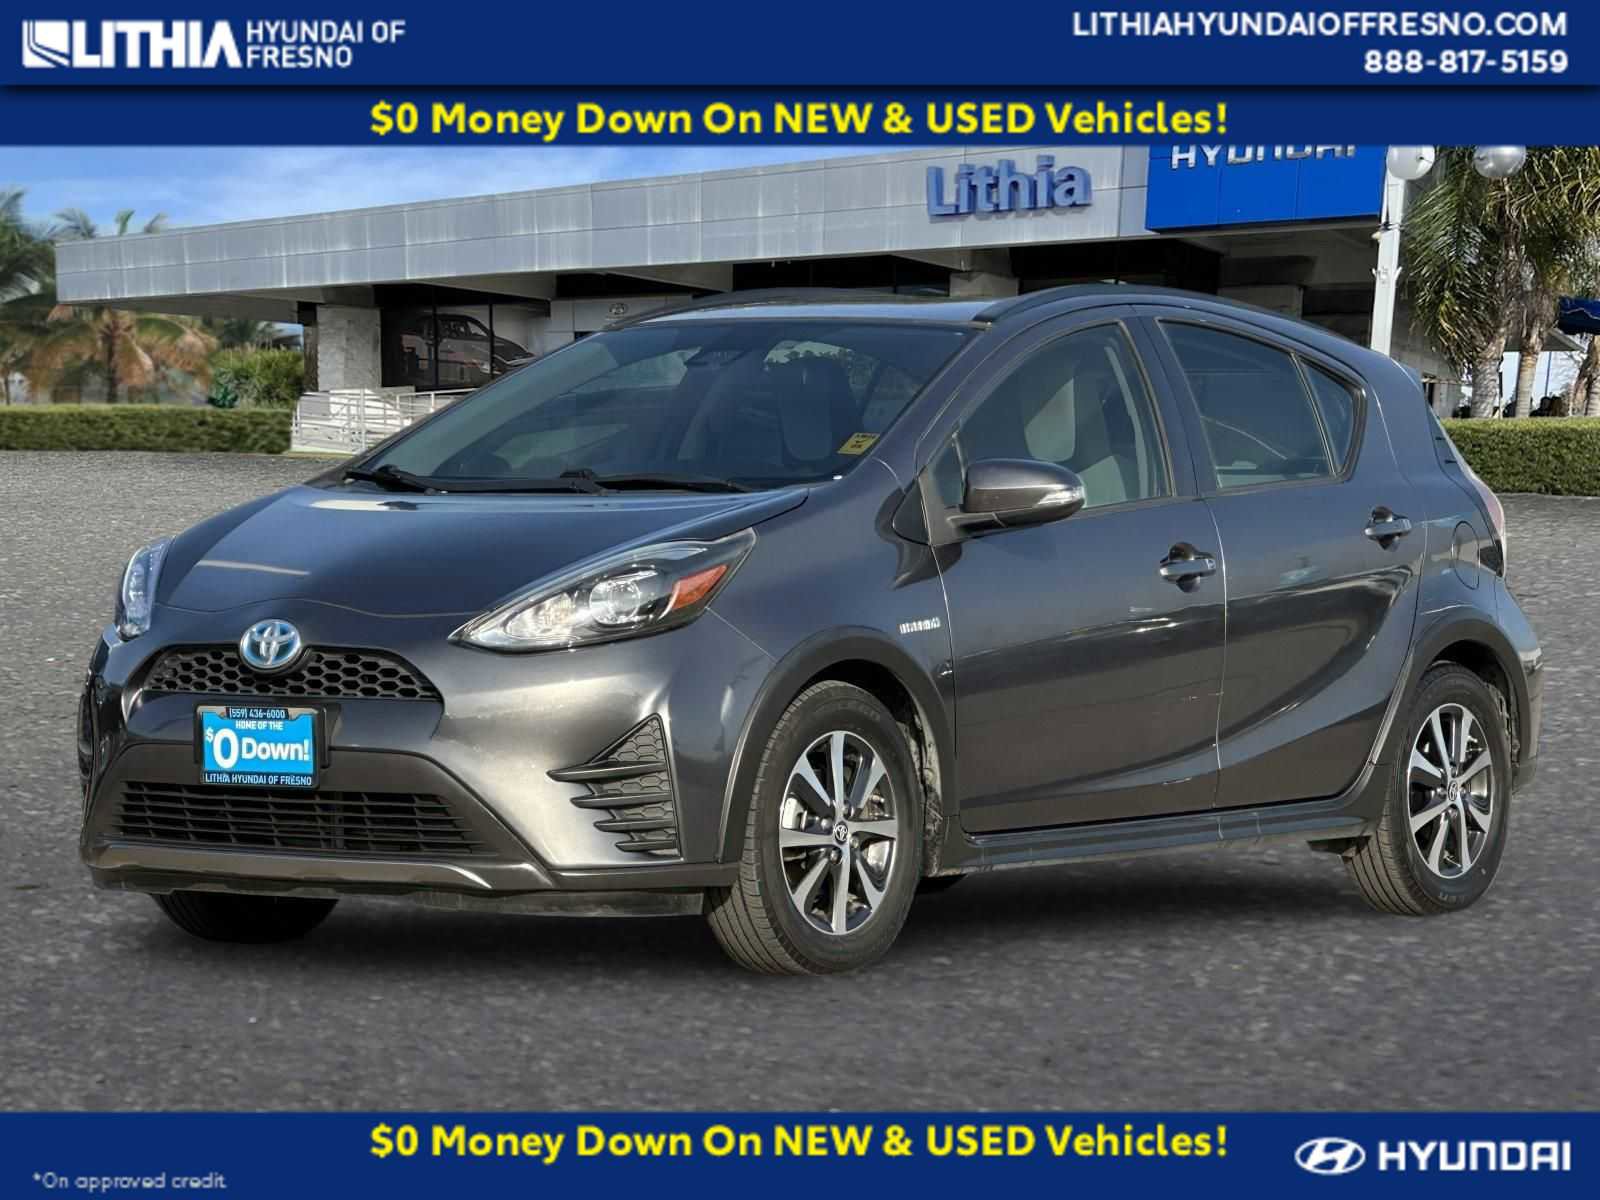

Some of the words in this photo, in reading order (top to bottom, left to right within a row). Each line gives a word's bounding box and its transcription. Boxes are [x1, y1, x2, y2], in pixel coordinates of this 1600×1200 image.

[926, 154, 1093, 217] Lithia
[235, 720, 256, 729] HOME
[257, 721, 267, 730] OF
[268, 721, 284, 731] THE
[205, 726, 240, 769] $0
[241, 736, 310, 761] Down!
[205, 773, 231, 783] LITHIA
[231, 774, 267, 784] HYUNDAI
[268, 775, 279, 785] OF
[280, 775, 312, 786] FRESNO
